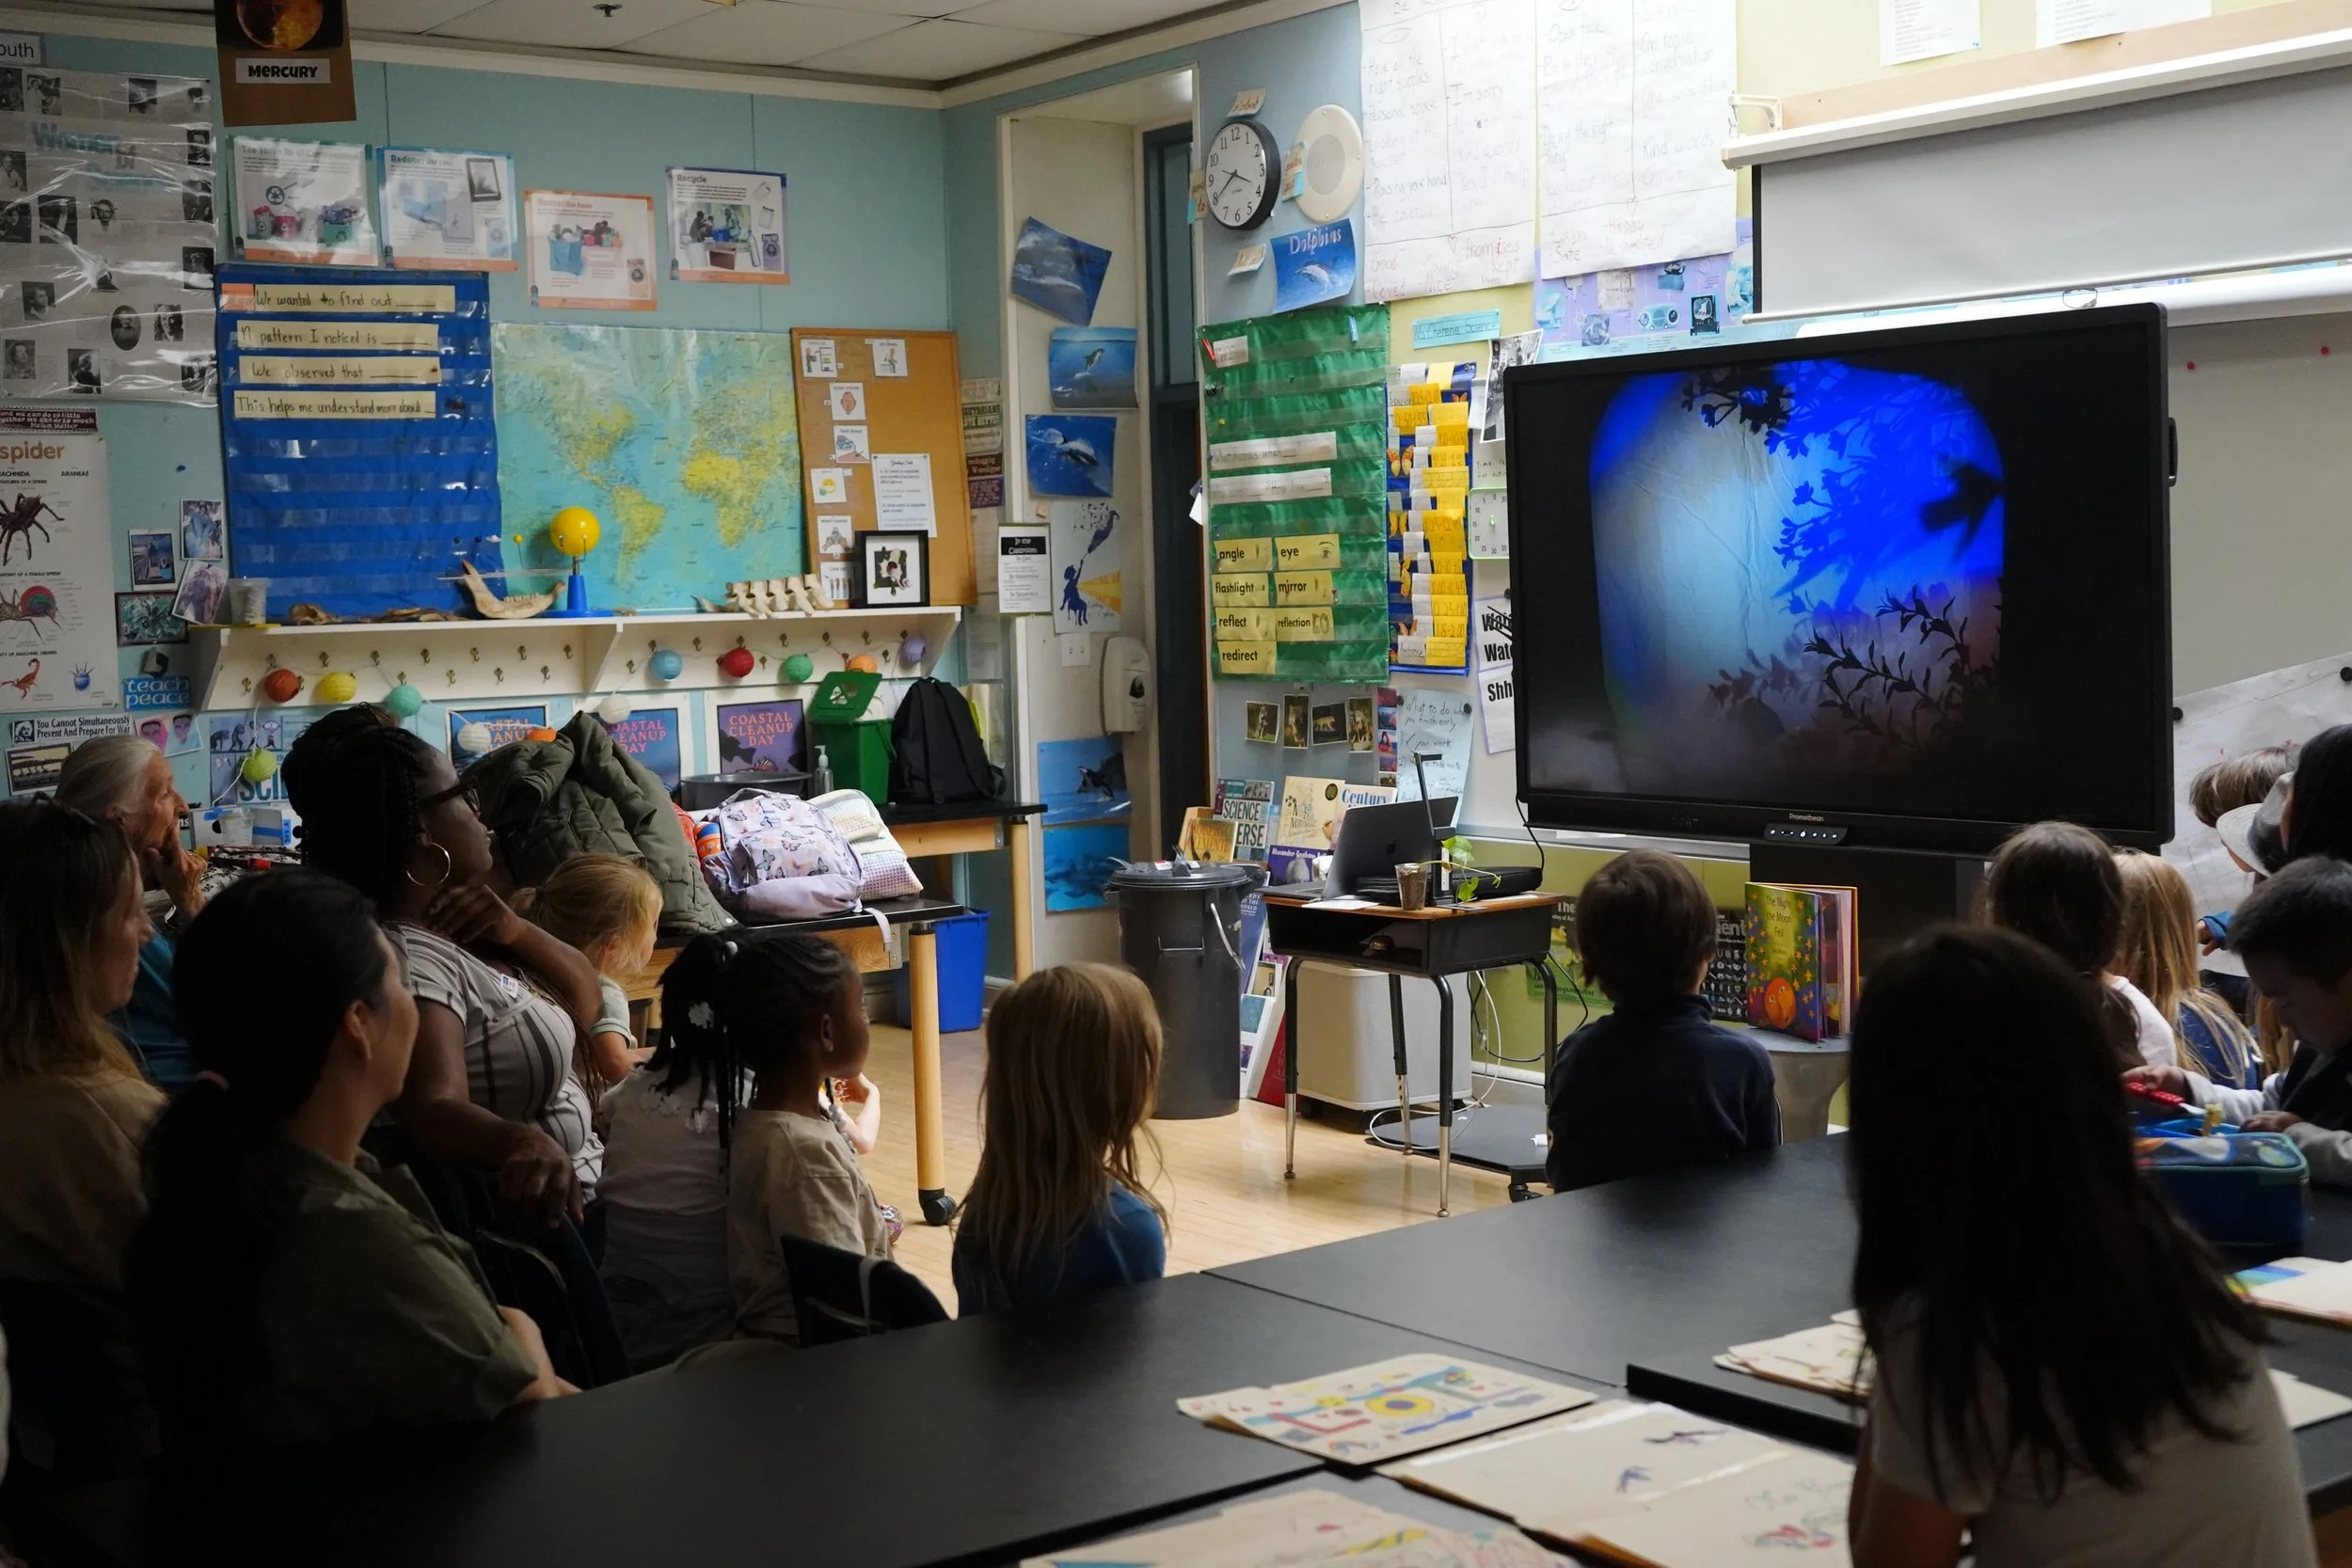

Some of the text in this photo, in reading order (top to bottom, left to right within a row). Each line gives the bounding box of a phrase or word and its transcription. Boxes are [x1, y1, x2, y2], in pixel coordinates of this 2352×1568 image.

[1232, 128, 1241, 141] 12
[1246, 132, 1250, 144] 1
[1220, 137, 1228, 150] 11
[1254, 144, 1261, 158] 2
[1210, 154, 1218, 166] 10
[1260, 164, 1265, 178] 3
[1208, 174, 1215, 187] 9
[1256, 183, 1262, 198] 4
[1213, 192, 1219, 205] 8
[1223, 206, 1229, 220] 7
[1247, 201, 1253, 214] 5
[1234, 208, 1241, 222] 6
[1290, 227, 1343, 255] Dolphins
[256, 291, 269, 306] We
[278, 292, 310, 307] wanted
[340, 292, 365, 307] find
[372, 293, 392, 307] out
[261, 327, 302, 350] pattern
[310, 329, 318, 343] I
[325, 327, 359, 343] noticed
[367, 333, 377, 344] is
[252, 361, 363, 378] We observed that
[236, 397, 264, 412] This
[269, 397, 296, 419] helps
[299, 404, 313, 414] me
[318, 400, 374, 414] understand
[376, 404, 397, 414] more
[0, 440, 65, 464] spider
[1218, 547, 1246, 562] angle
[1280, 547, 1299, 562] eye
[1216, 582, 1255, 595] flashlight
[1278, 579, 1308, 592] mirror
[1218, 613, 1247, 627] reflect
[1278, 616, 1311, 627] reflection
[1222, 648, 1258, 661] redirect
[127, 677, 190, 693] teach
[126, 692, 191, 710] peace
[1405, 696, 1426, 713] What
[1440, 701, 1450, 716] do
[37, 717, 130, 728] You Cannot Simultaneously
[730, 712, 792, 726] COASTAL
[37, 728, 62, 738] Prevent
[64, 728, 77, 736] And
[78, 727, 104, 737] Prepare
[118, 725, 130, 735] War
[730, 723, 793, 737] CLEANUP
[749, 736, 775, 746] DAY
[1223, 800, 1262, 821] SCIENCE
[1788, 813, 1824, 822] Promethean
[1235, 824, 1265, 847] ERSE
[1272, 847, 1316, 859] Alexander Graham
[1557, 900, 1577, 913] The
[1766, 895, 1792, 910] The Night
[1766, 910, 1792, 924] the Moon
